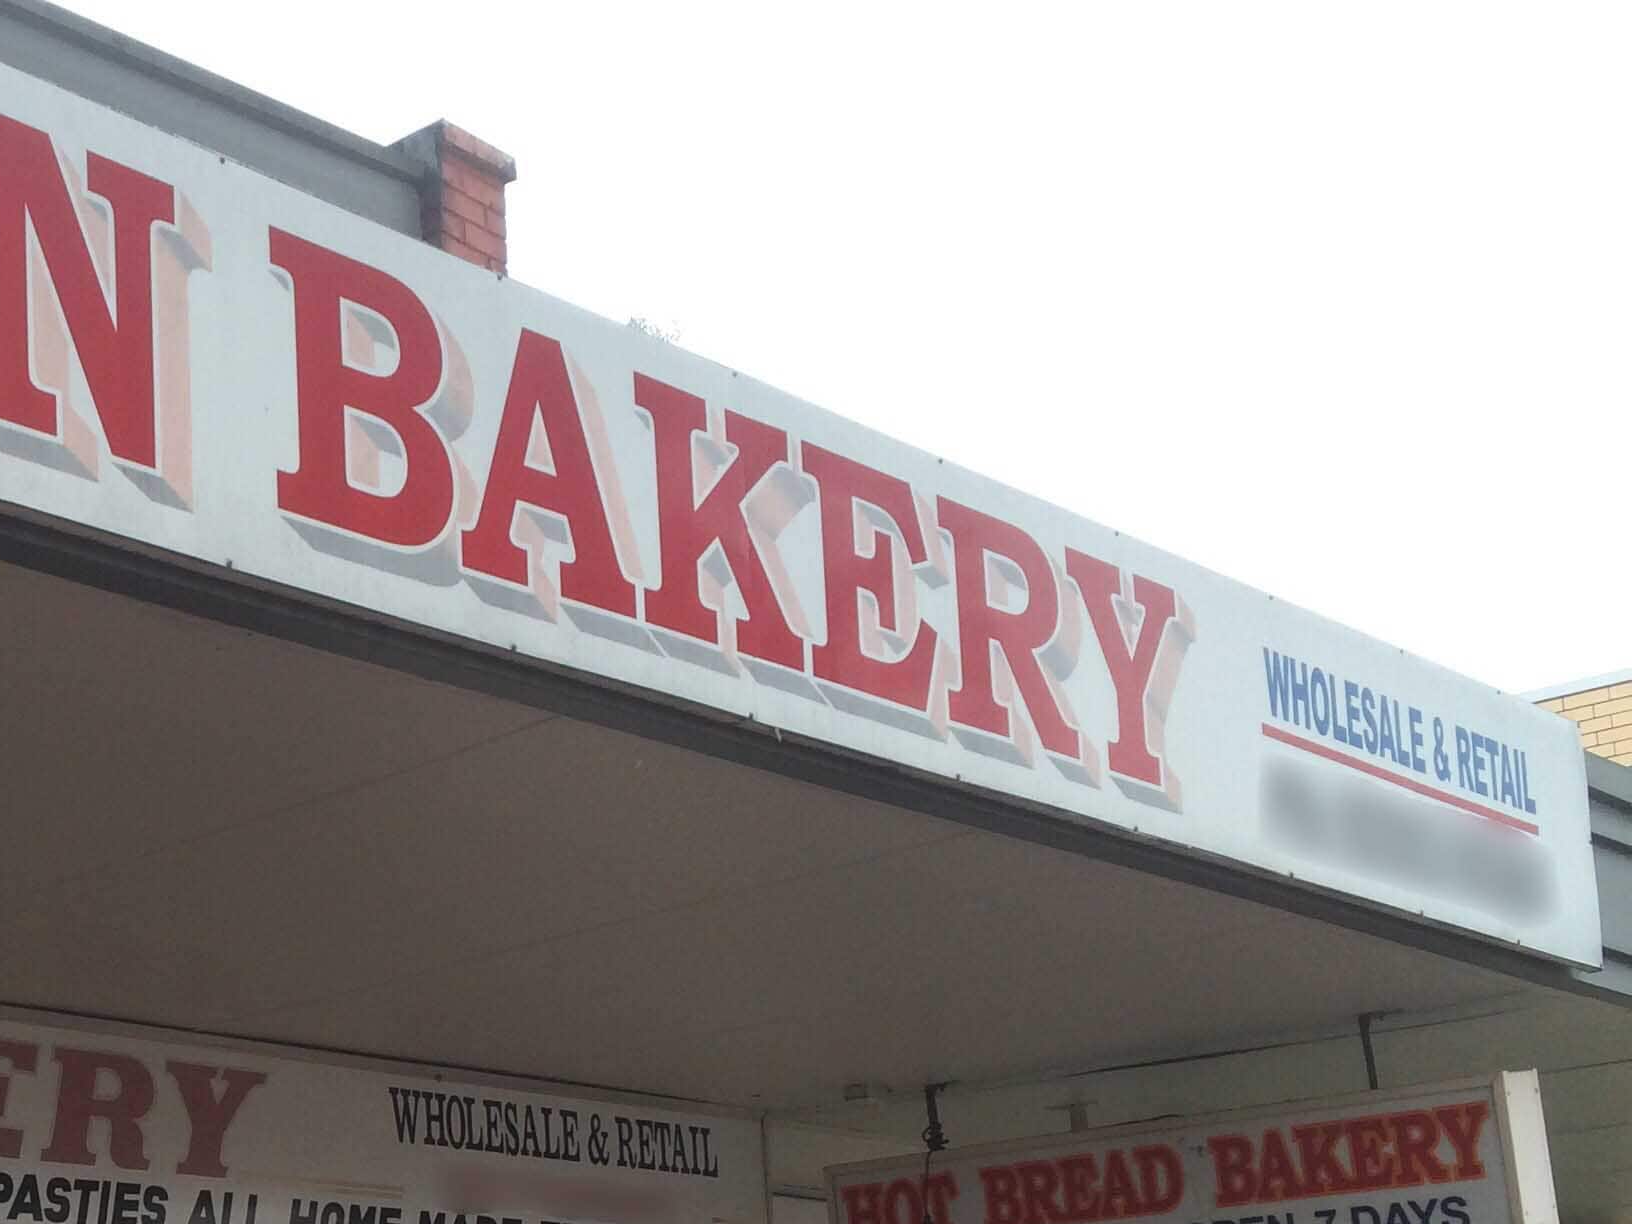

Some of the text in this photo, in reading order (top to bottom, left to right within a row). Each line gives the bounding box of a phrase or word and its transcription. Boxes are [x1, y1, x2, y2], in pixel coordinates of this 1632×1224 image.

[268, 224, 1178, 790] BAKERY
[1263, 646, 1537, 816] WHOLESALE & RETAIL
[388, 1086, 720, 1179] WHOLESALE & RETAIL
[1206, 1100, 1490, 1210] BAKERY
